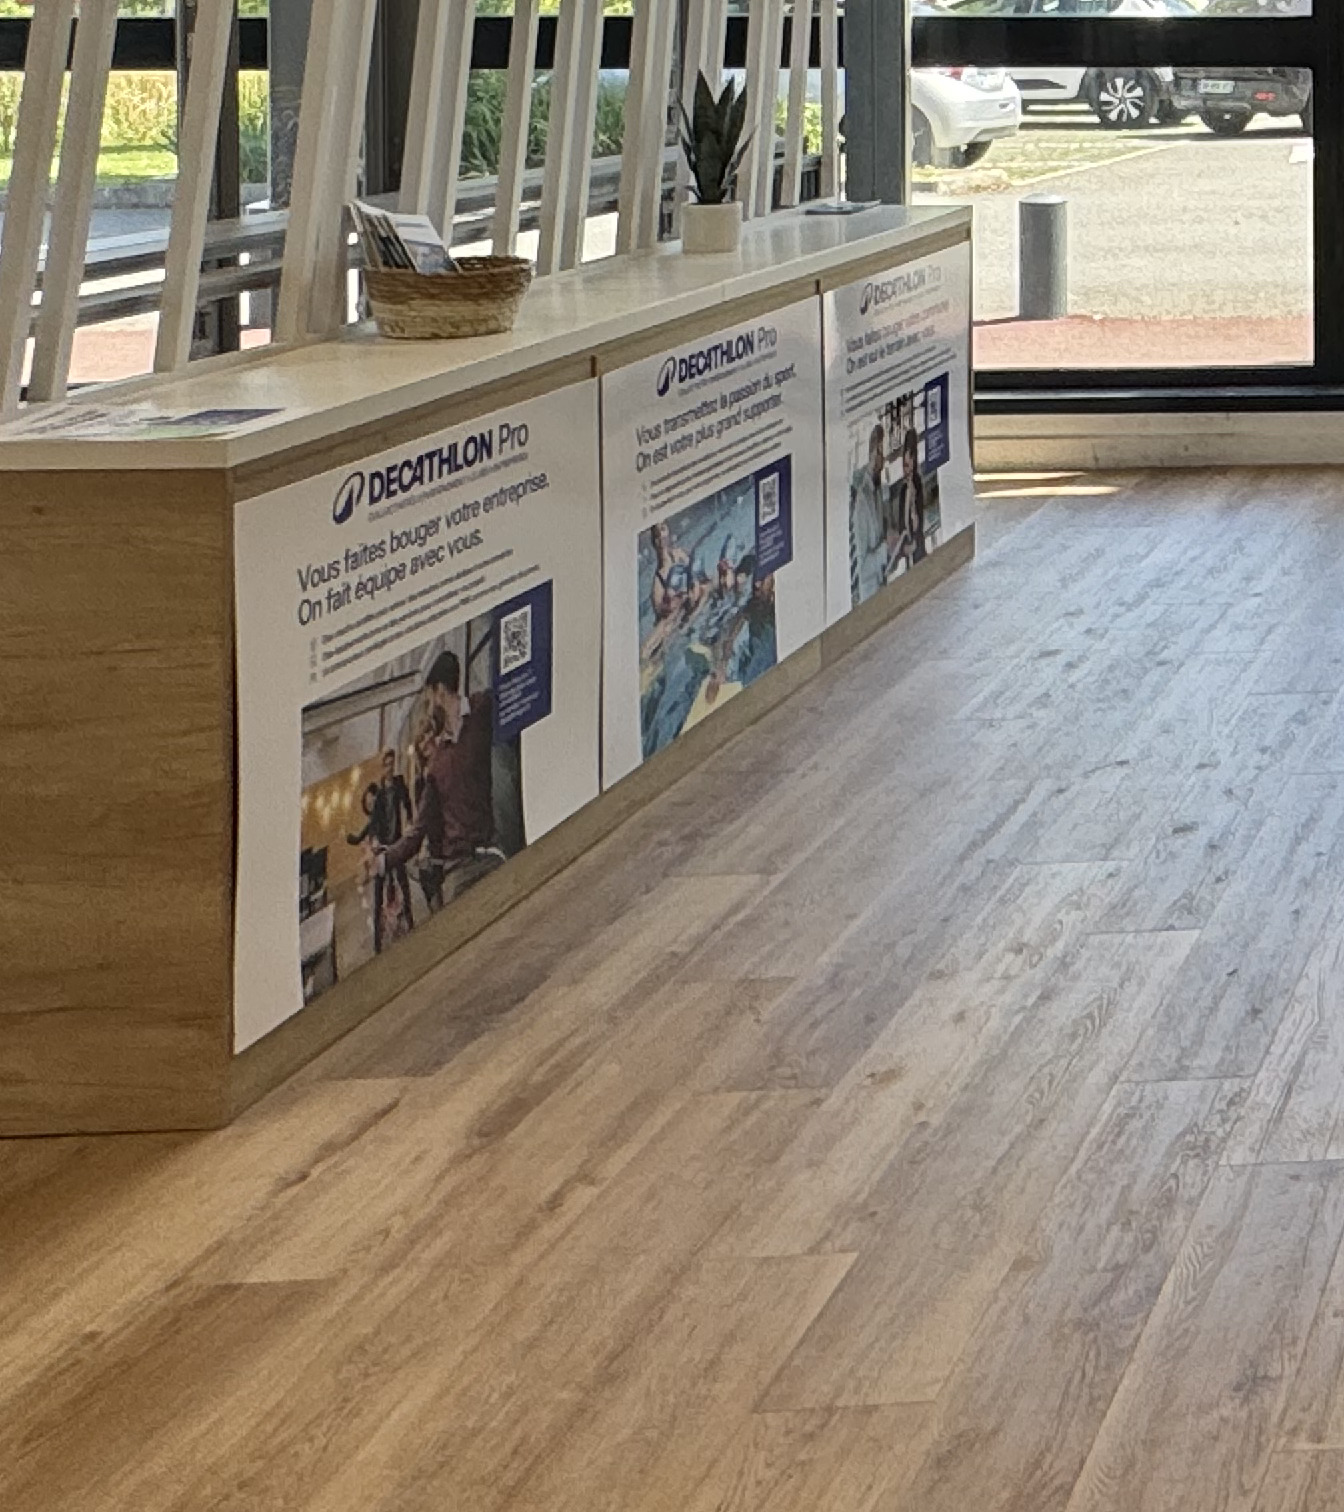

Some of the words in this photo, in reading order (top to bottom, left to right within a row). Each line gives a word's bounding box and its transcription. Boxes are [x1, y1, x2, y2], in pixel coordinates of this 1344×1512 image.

[679, 332, 755, 384] DECATHLON
[757, 326, 777, 351] Pro
[635, 422, 661, 446] Vous
[728, 378, 761, 412] passion
[635, 451, 651, 473] On
[652, 445, 668, 466] est
[670, 433, 694, 456] votre
[695, 424, 715, 449] plus
[716, 406, 742, 440] grand
[368, 428, 494, 506] DECATHLON
[498, 422, 529, 455] Pro
[297, 558, 340, 592] Vous
[344, 540, 386, 574] faites
[390, 516, 443, 554] bouger
[446, 500, 481, 528] votre
[483, 472, 550, 515] entreprise.
[298, 598, 322, 626] On
[326, 581, 351, 615] fait
[355, 560, 407, 601] équipe
[410, 545, 445, 575] avec
[449, 527, 484, 558] vous.
